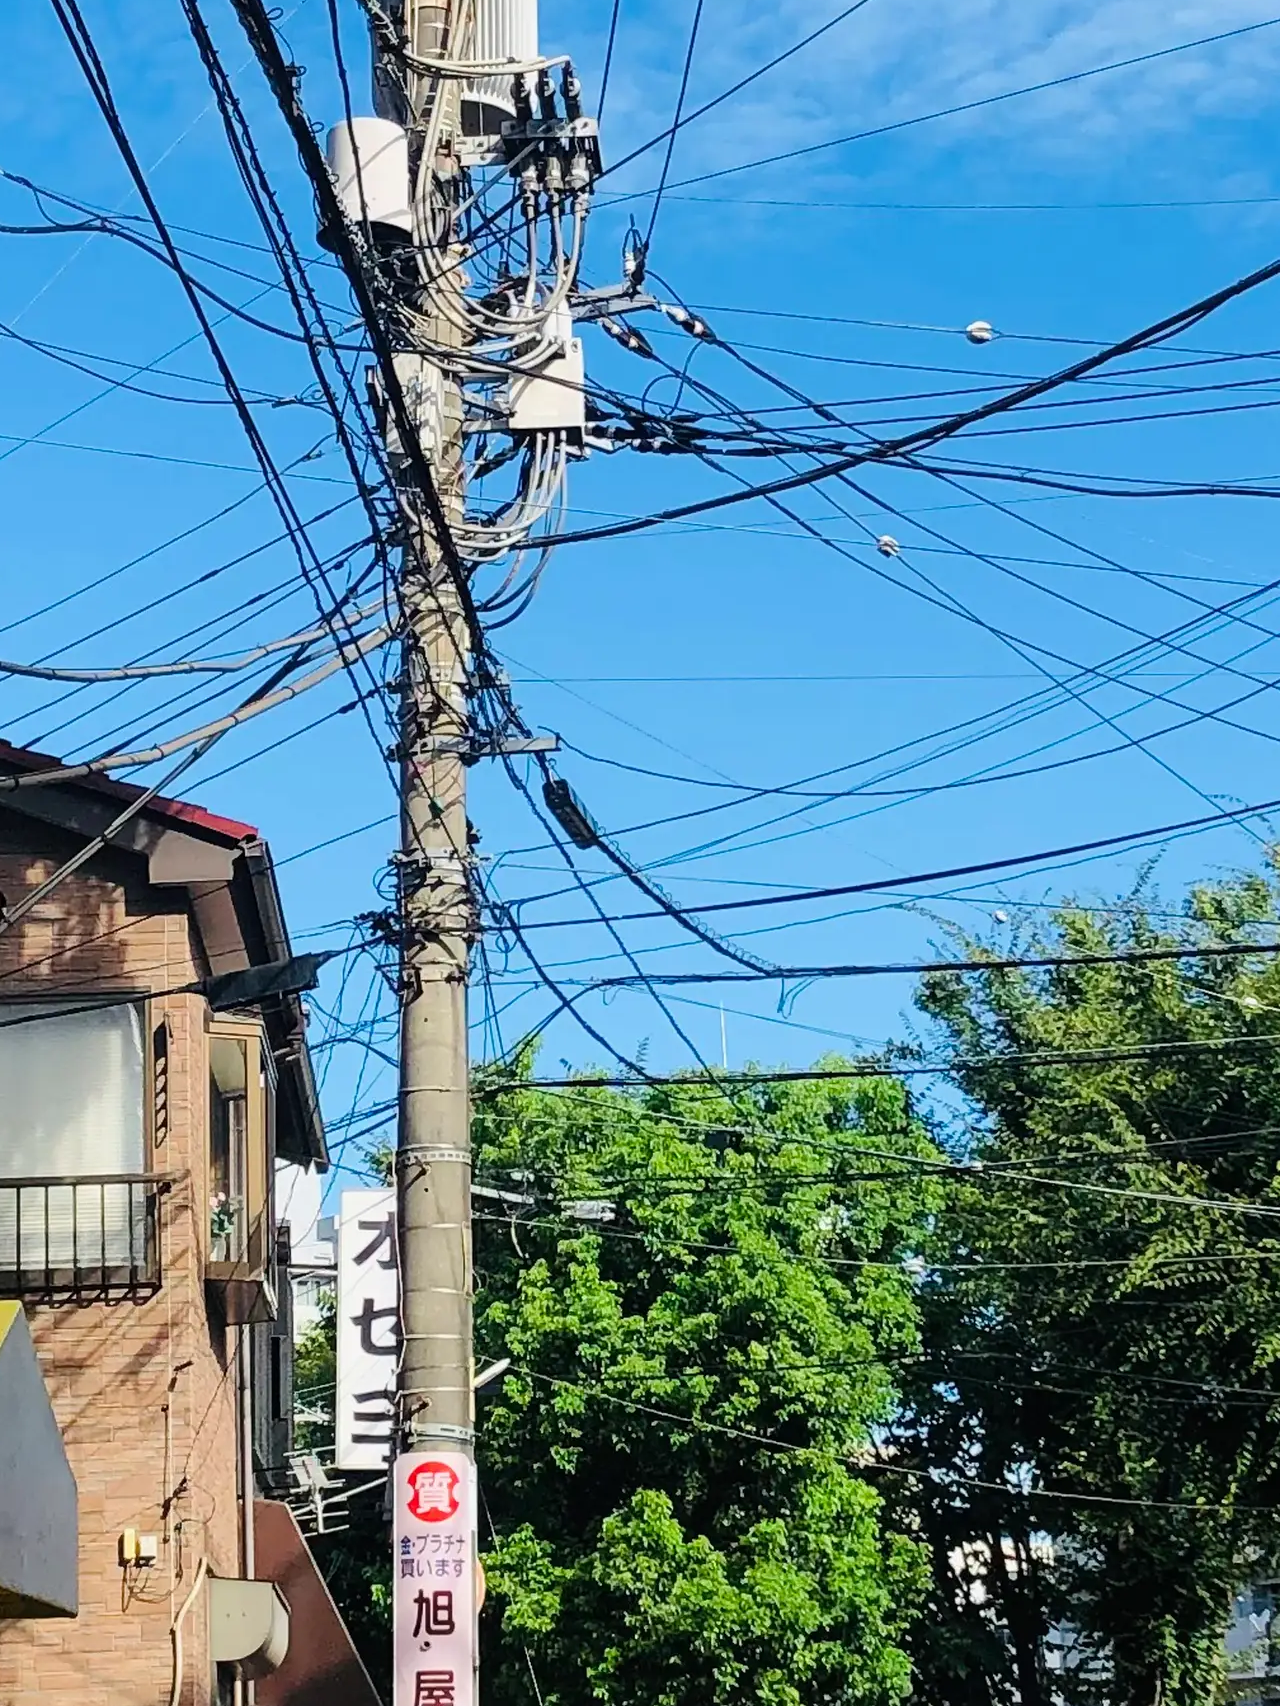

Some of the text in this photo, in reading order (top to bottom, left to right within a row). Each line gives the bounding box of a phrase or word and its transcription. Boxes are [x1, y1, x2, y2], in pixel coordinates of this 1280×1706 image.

[414, 1470, 453, 1515] 質
[400, 1558, 466, 1579] 買います
